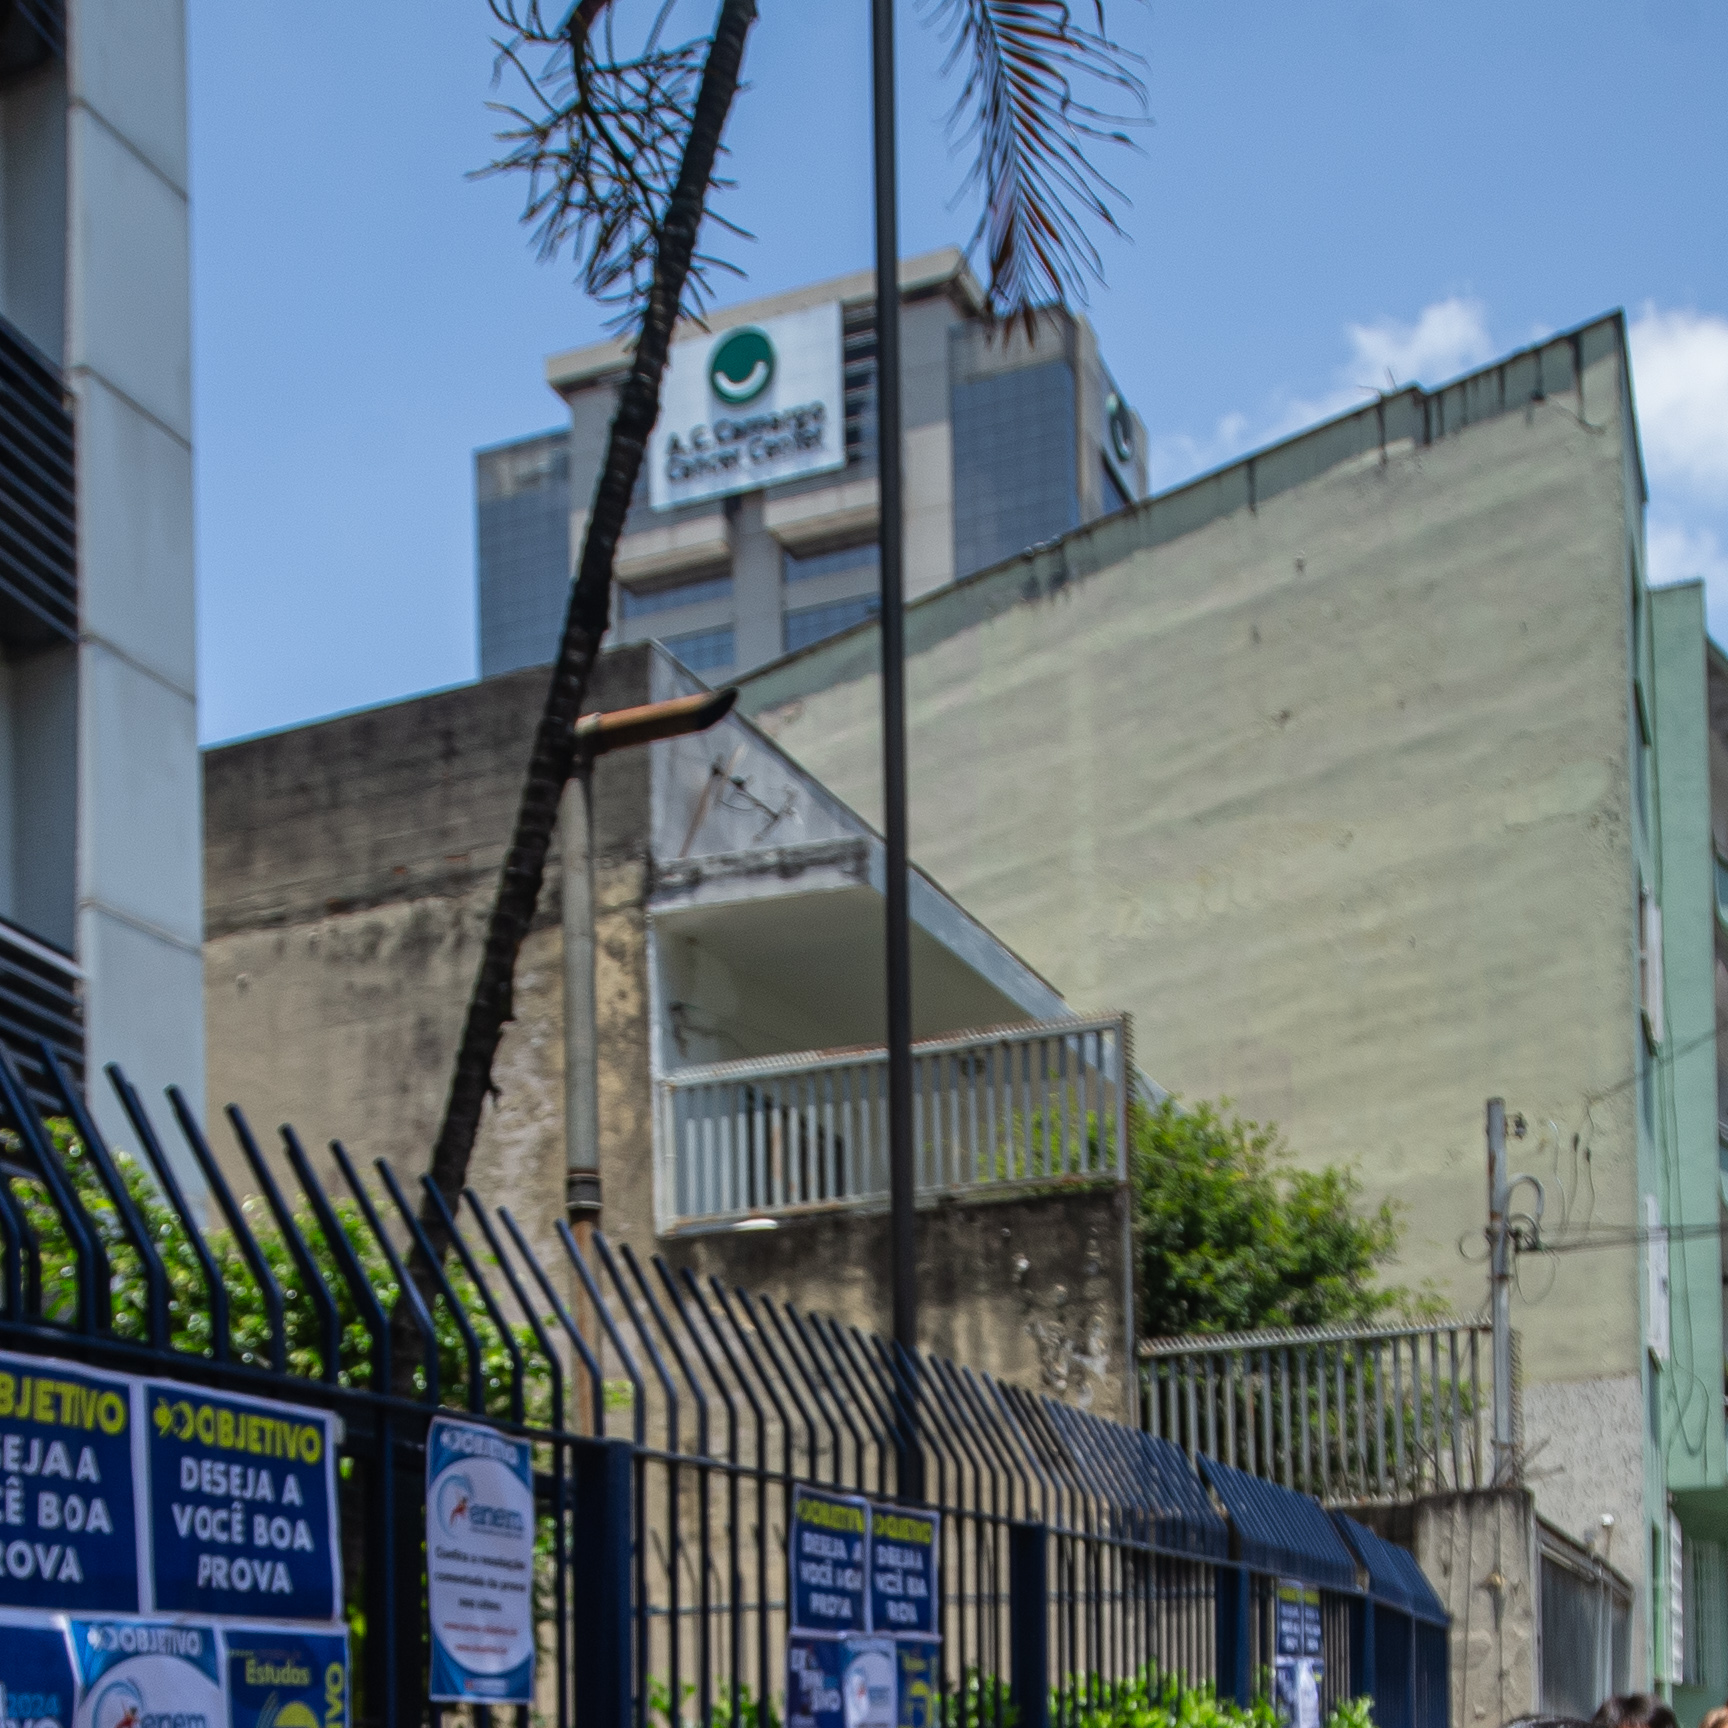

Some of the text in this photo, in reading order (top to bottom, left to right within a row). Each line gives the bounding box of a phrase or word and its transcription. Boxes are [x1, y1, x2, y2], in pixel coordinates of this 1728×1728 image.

[200, 1404, 322, 1466] OBJETIVO
[75, 1445, 101, 1484] A
[180, 1455, 304, 1508] DESEJA A
[37, 1490, 113, 1536] BOA
[172, 1501, 314, 1553] VOCÊ BOA
[198, 1552, 294, 1595] PROVA
[245, 1658, 311, 1687] Estudos
